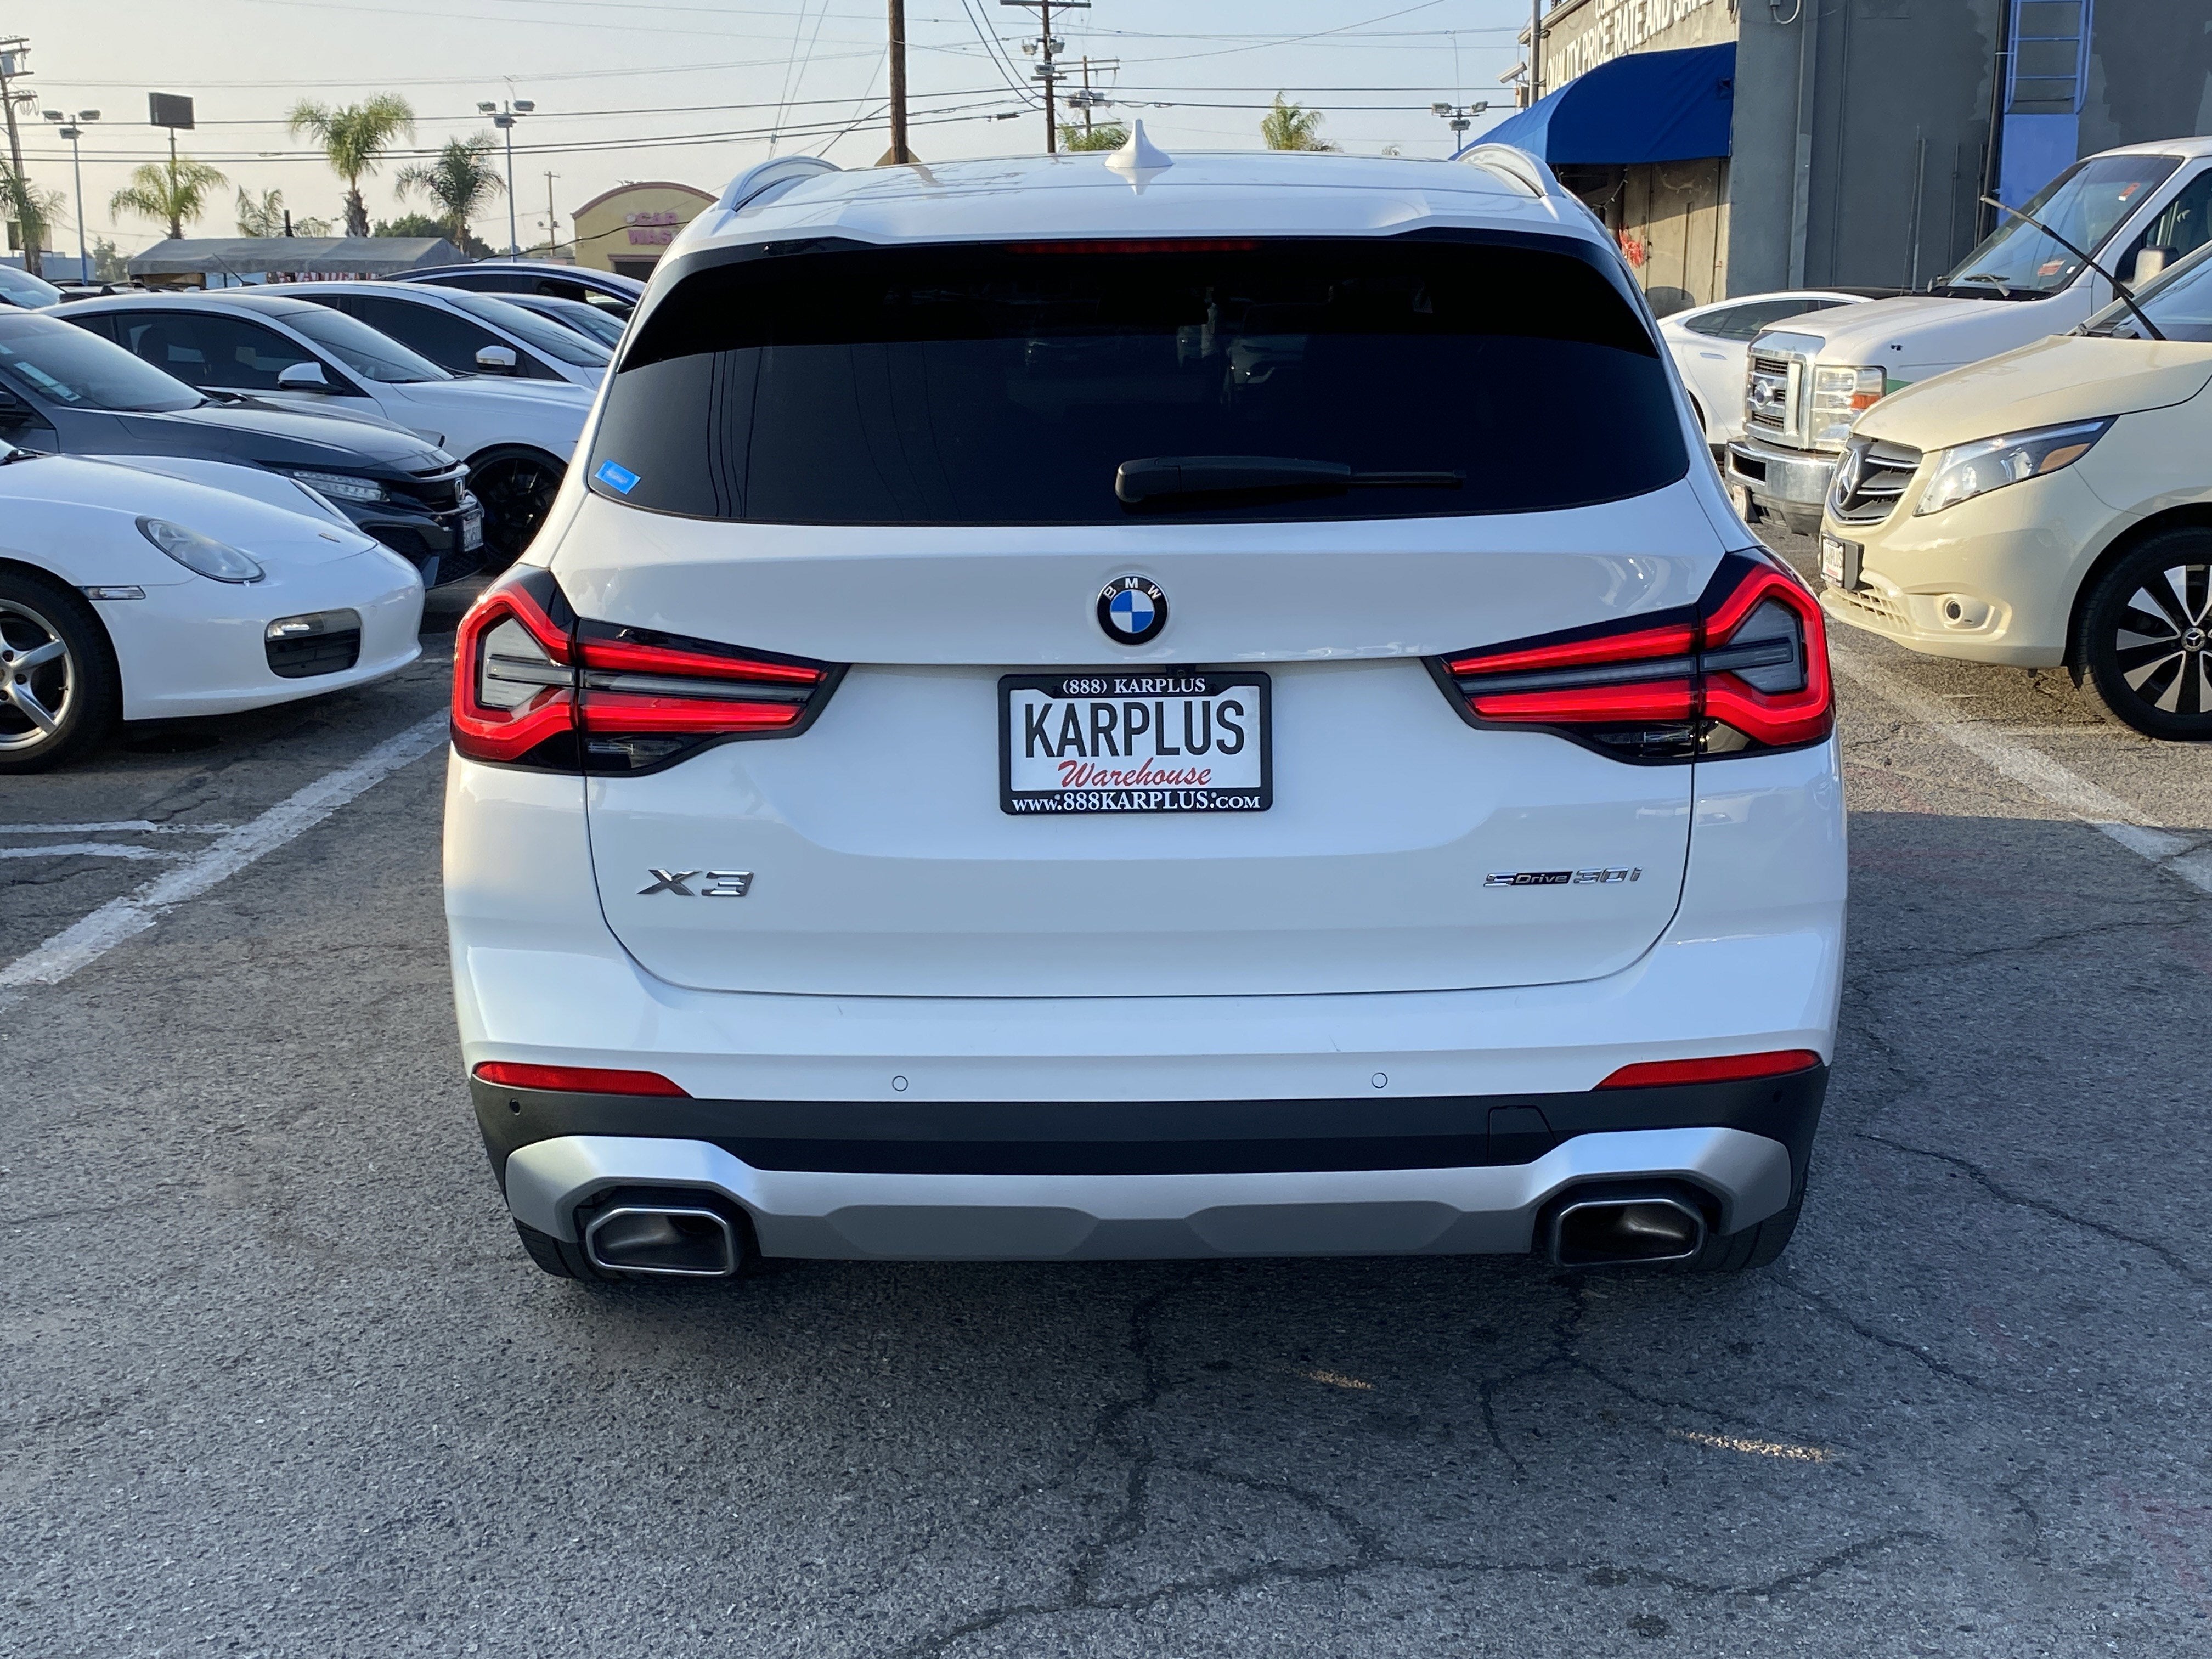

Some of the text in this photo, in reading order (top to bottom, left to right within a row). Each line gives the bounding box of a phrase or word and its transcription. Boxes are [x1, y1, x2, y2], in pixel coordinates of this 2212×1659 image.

[1615, 0, 1643, 56] RATE
[628, 229, 673, 245] WAS
[1103, 578, 1162, 600] BMW
[1063, 678, 1206, 695] (888) KARPLUS
[1025, 700, 1245, 758] KARPLUS
[1058, 758, 1212, 788] Warehouse
[636, 869, 754, 897] X3
